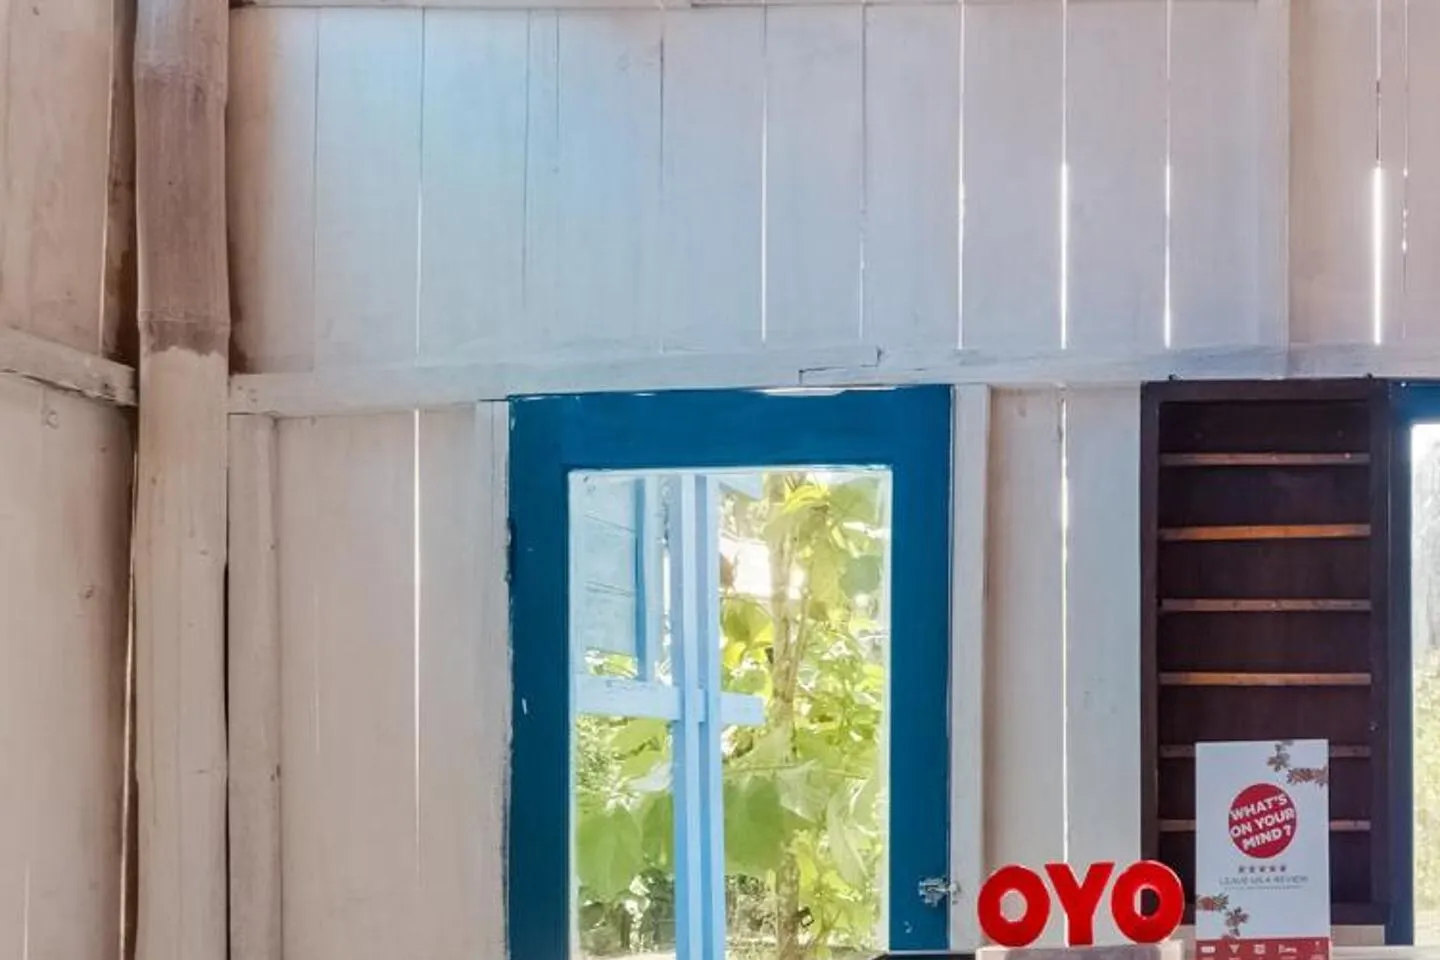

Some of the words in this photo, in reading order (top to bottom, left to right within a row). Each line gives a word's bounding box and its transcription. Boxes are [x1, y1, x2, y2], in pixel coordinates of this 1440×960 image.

[1230, 794, 1287, 820] WHAT'S
[1230, 822, 1252, 837] ON
[1254, 807, 1295, 829] YOUR
[977, 860, 1185, 948] OYO
